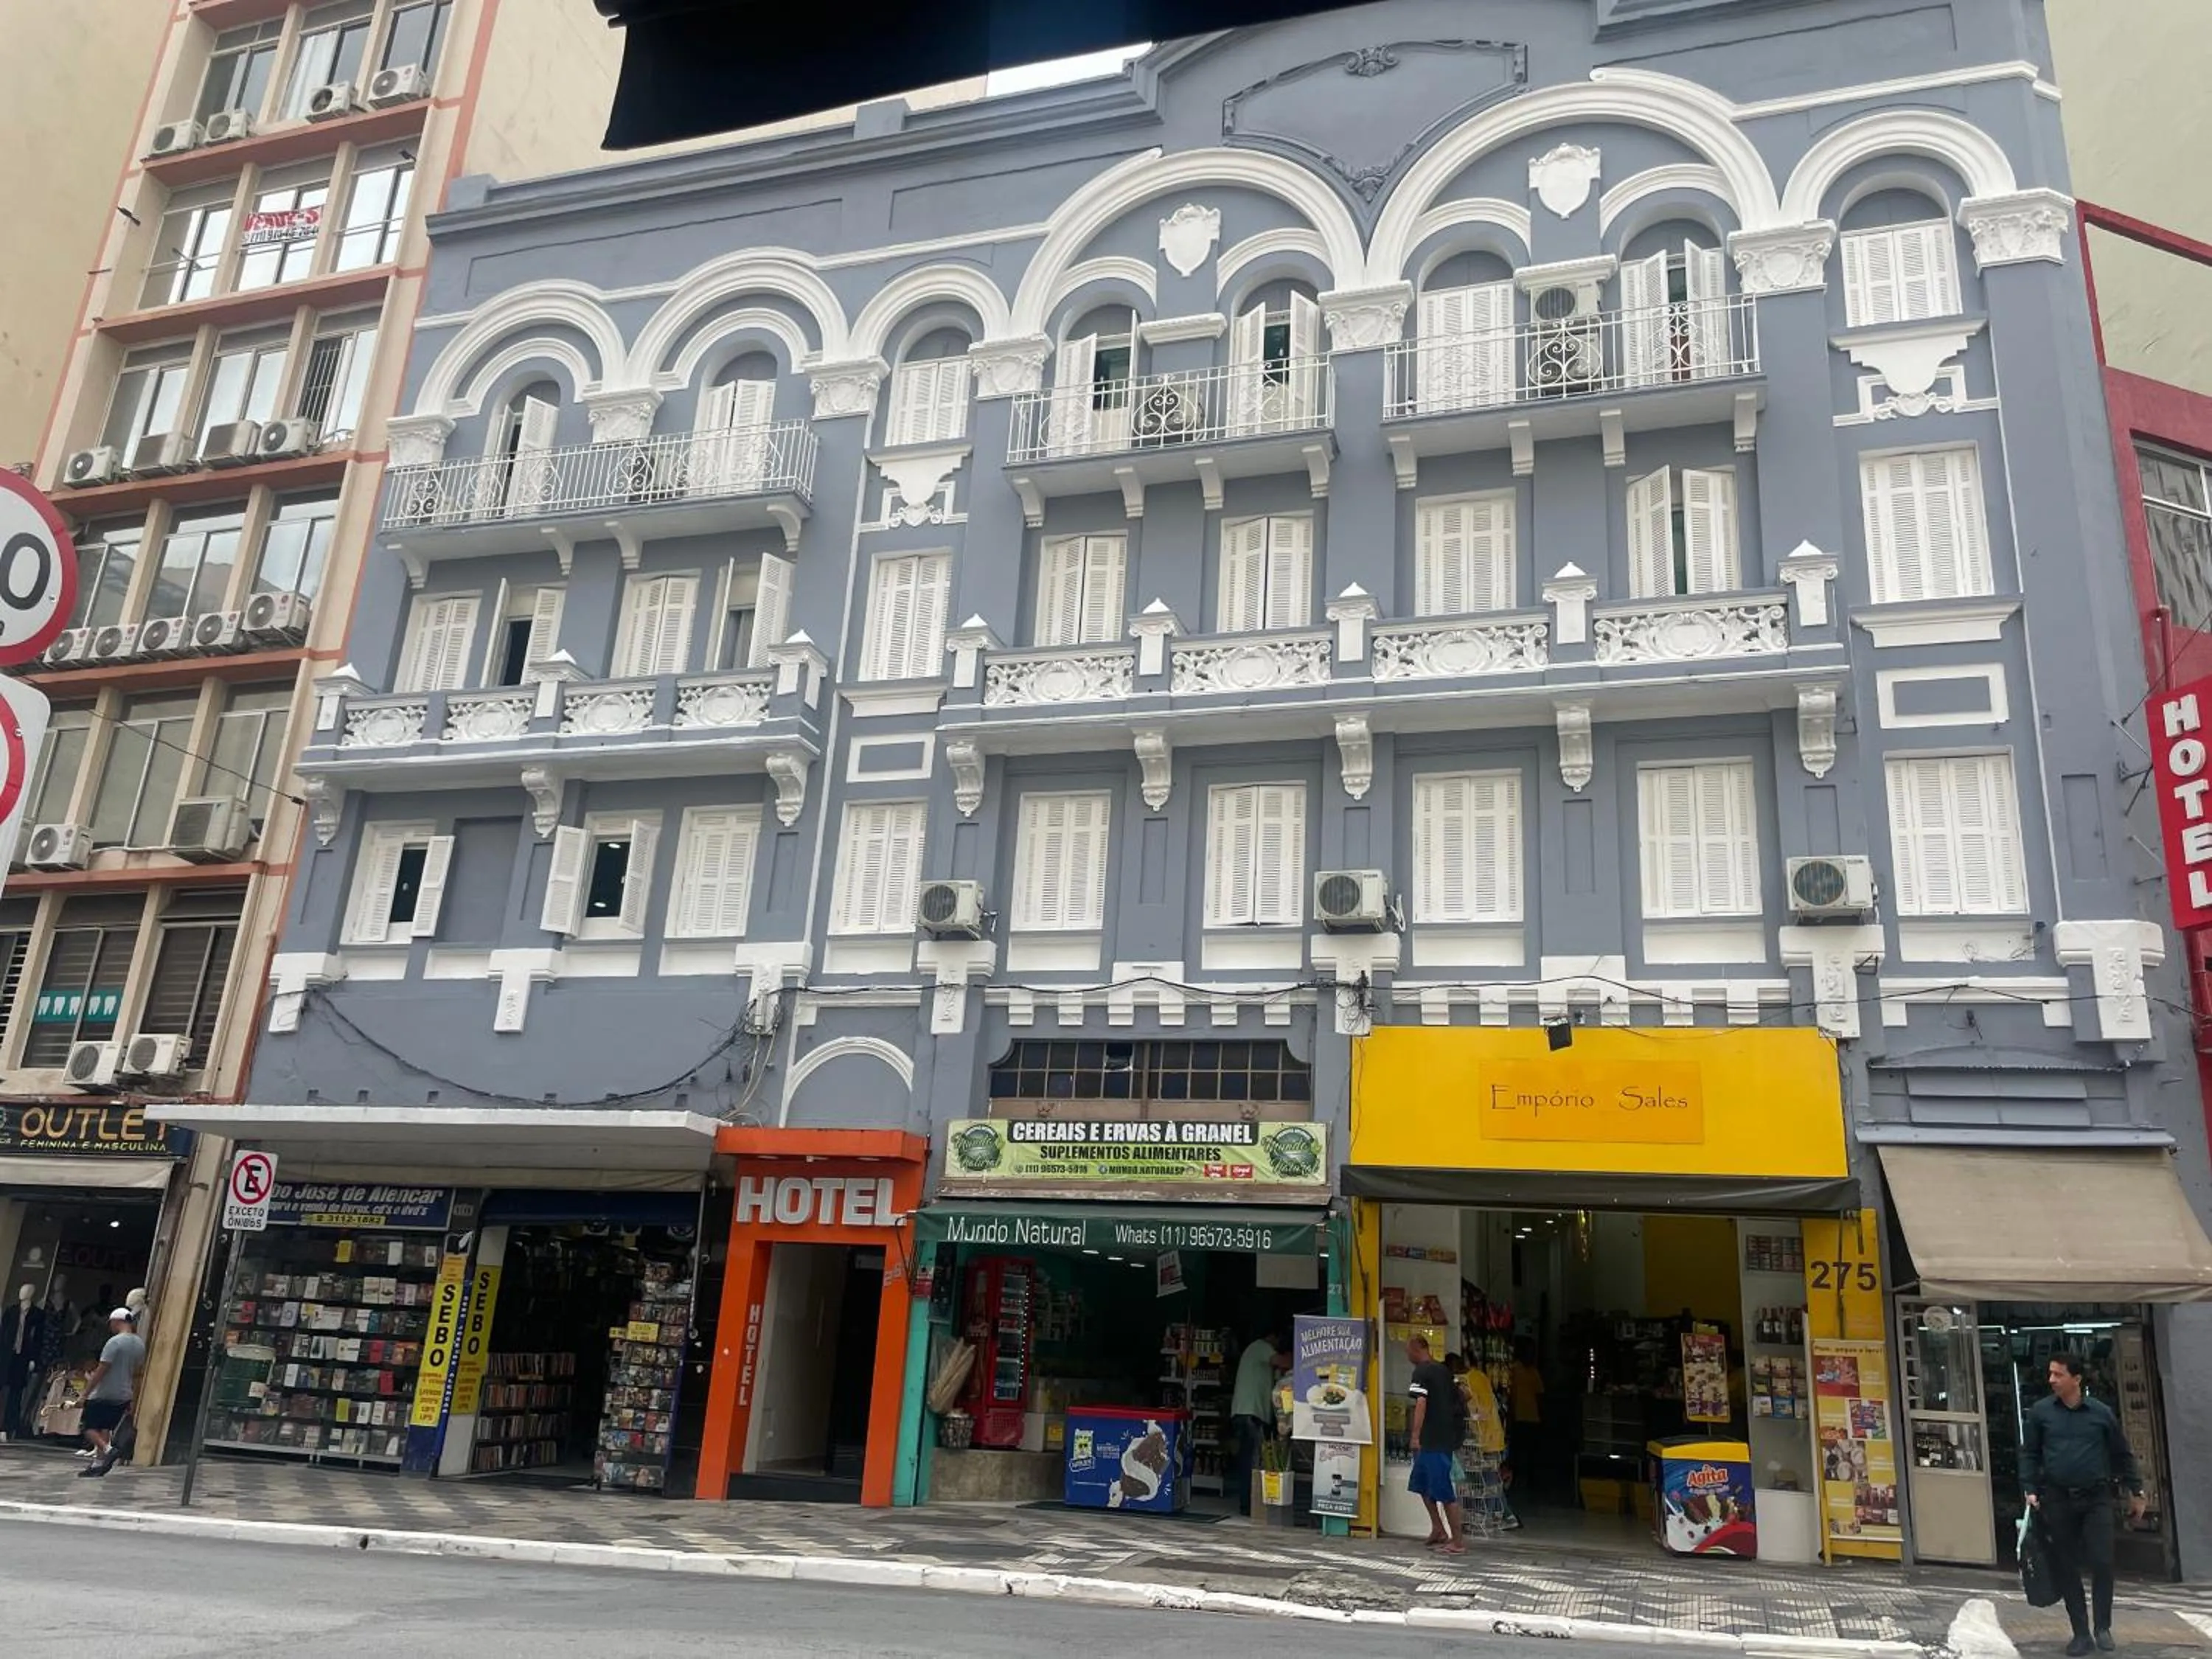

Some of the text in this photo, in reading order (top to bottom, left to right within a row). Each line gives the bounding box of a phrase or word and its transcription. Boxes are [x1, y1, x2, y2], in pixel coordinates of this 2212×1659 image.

[244, 209, 319, 231] VENDE-S
[2163, 694, 2212, 908] HOTEL
[1491, 1084, 1688, 1118] Empório Sales
[20, 1139, 76, 1149] FEMININA
[94, 1142, 166, 1152] MASCULINA
[1012, 1122, 1083, 1141] CEREAIS
[1089, 1124, 1099, 1141] E
[1104, 1123, 1161, 1142] ERVAS
[1164, 1120, 1178, 1142] À
[1181, 1123, 1253, 1144] GRANEL
[1040, 1146, 1221, 1161] SUPLEMENTOS ALIMENTARES
[229, 1206, 265, 1217] EXCETO
[736, 1176, 907, 1226] HOTEL
[947, 1217, 1087, 1245] Mundo Natural
[1115, 1224, 1272, 1249] Whats (11) 96573-5916
[1810, 1260, 1877, 1291] 275
[430, 1284, 456, 1366] SEBO
[467, 1272, 490, 1354] SEBO
[739, 1304, 761, 1406] HOTEL
[1688, 1464, 1728, 1486] Agita
